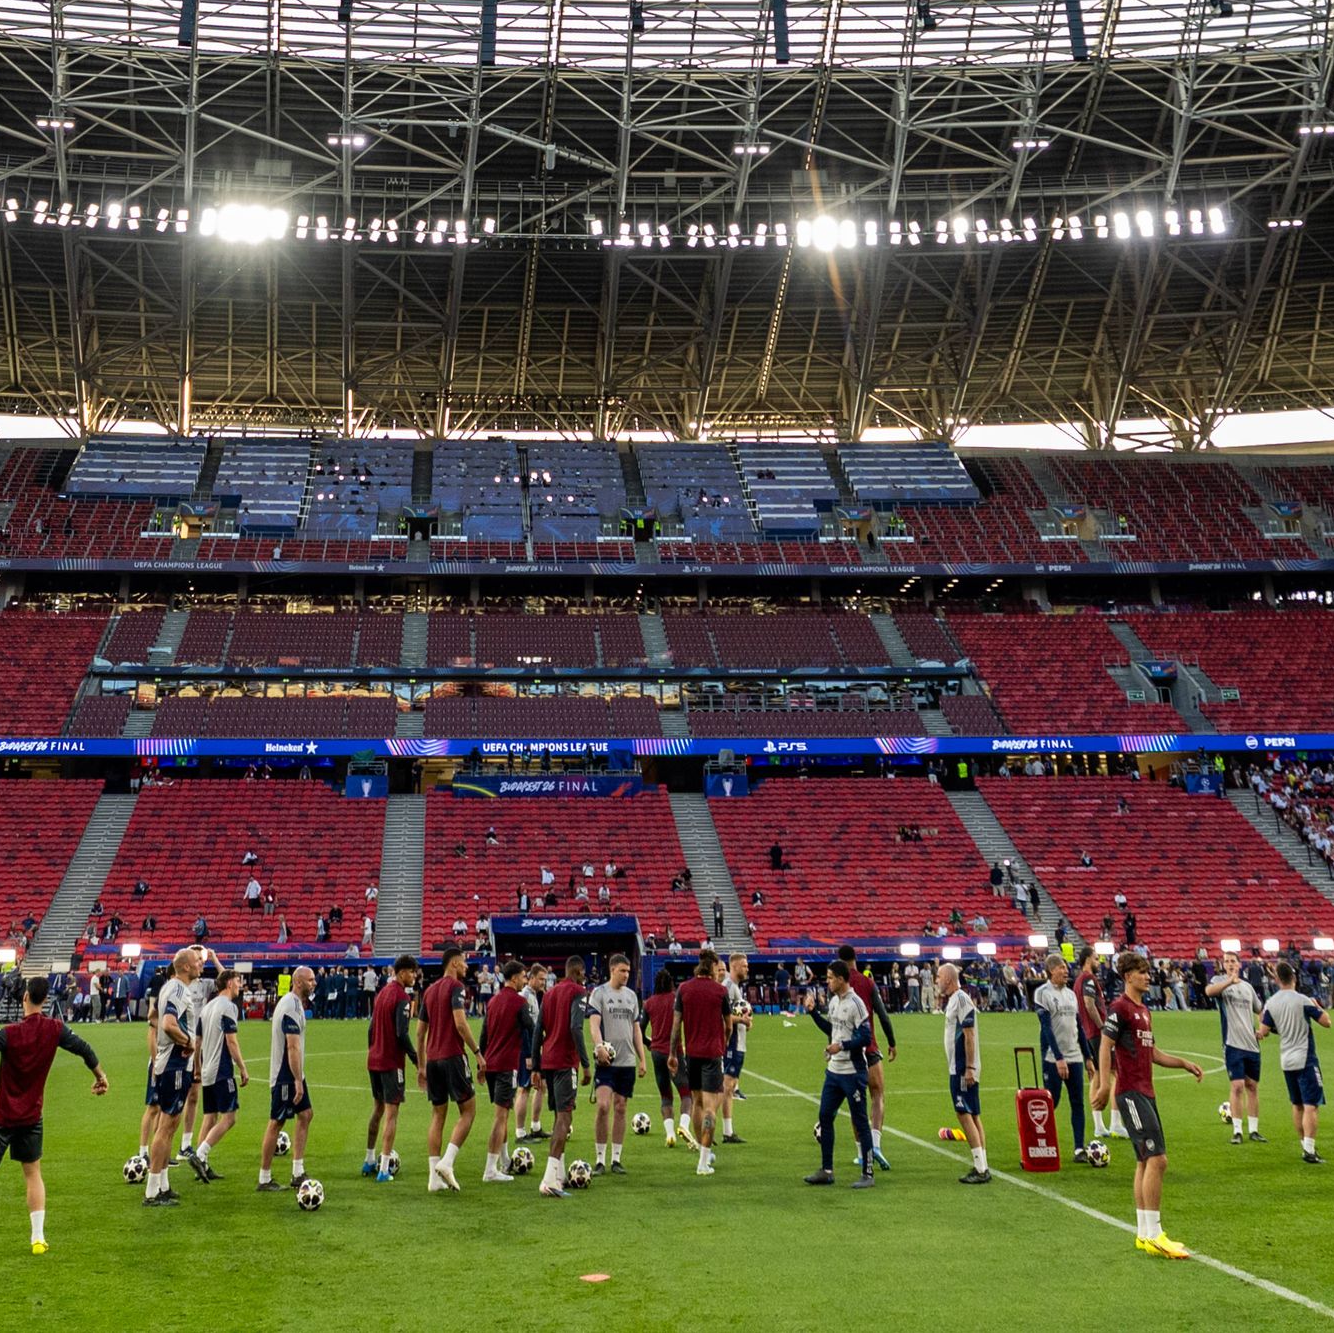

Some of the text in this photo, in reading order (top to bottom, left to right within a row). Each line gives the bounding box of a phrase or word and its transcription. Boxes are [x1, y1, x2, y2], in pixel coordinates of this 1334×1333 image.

[539, 565, 563, 573] FINAL
[1222, 562, 1247, 570] FINAL
[50, 741, 85, 751] FINAL
[482, 743, 507, 752] UEFA
[778, 742, 807, 752] PS5
[1040, 739, 1074, 749] FINAL
[1263, 737, 1296, 748] PEPSI
[265, 743, 304, 753] Heineken
[499, 780, 544, 793] BUDAPEST
[559, 781, 598, 792] FINAL
[521, 918, 608, 928] BUDAPEST 26
